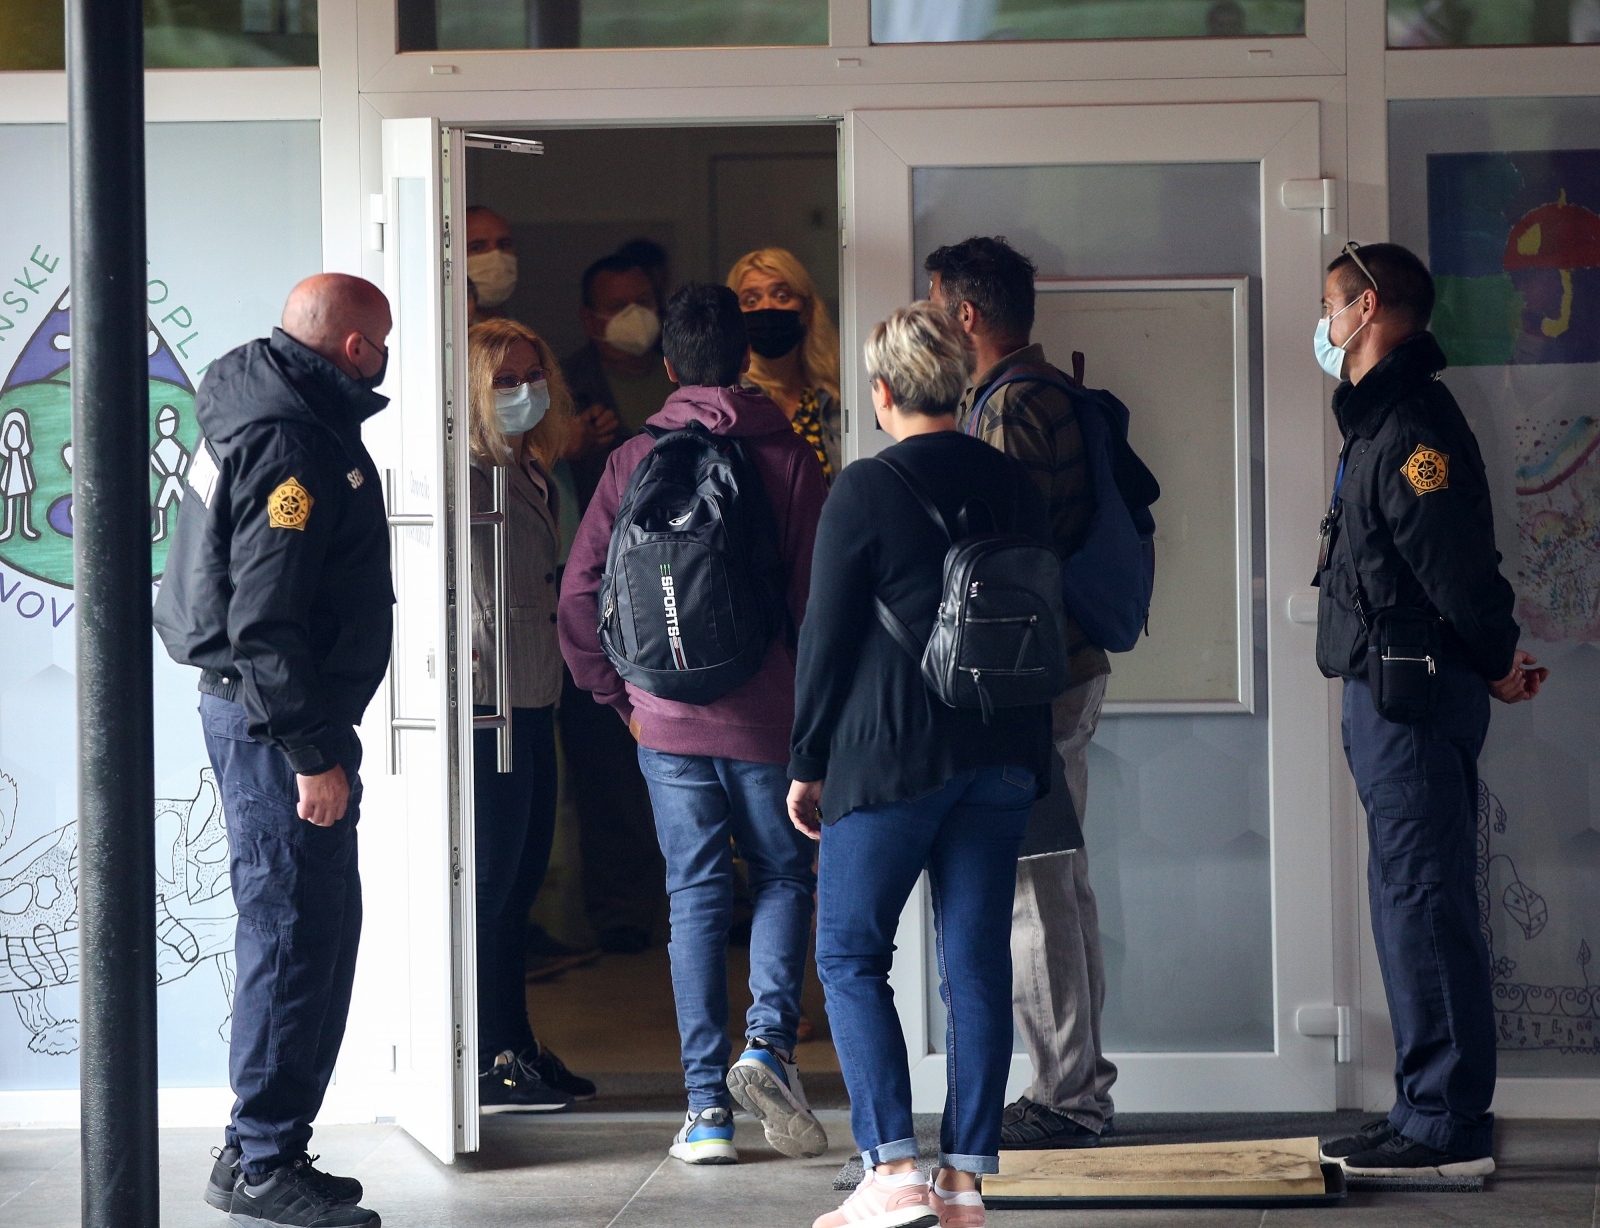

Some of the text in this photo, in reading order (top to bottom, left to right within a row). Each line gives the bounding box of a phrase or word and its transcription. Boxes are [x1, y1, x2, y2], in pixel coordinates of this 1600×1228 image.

[1410, 453, 1440, 468] VG TEH
[1412, 469, 1445, 487] SECURITY
[273, 506, 306, 523] SECURITY
[661, 576, 680, 636] SPORTS
